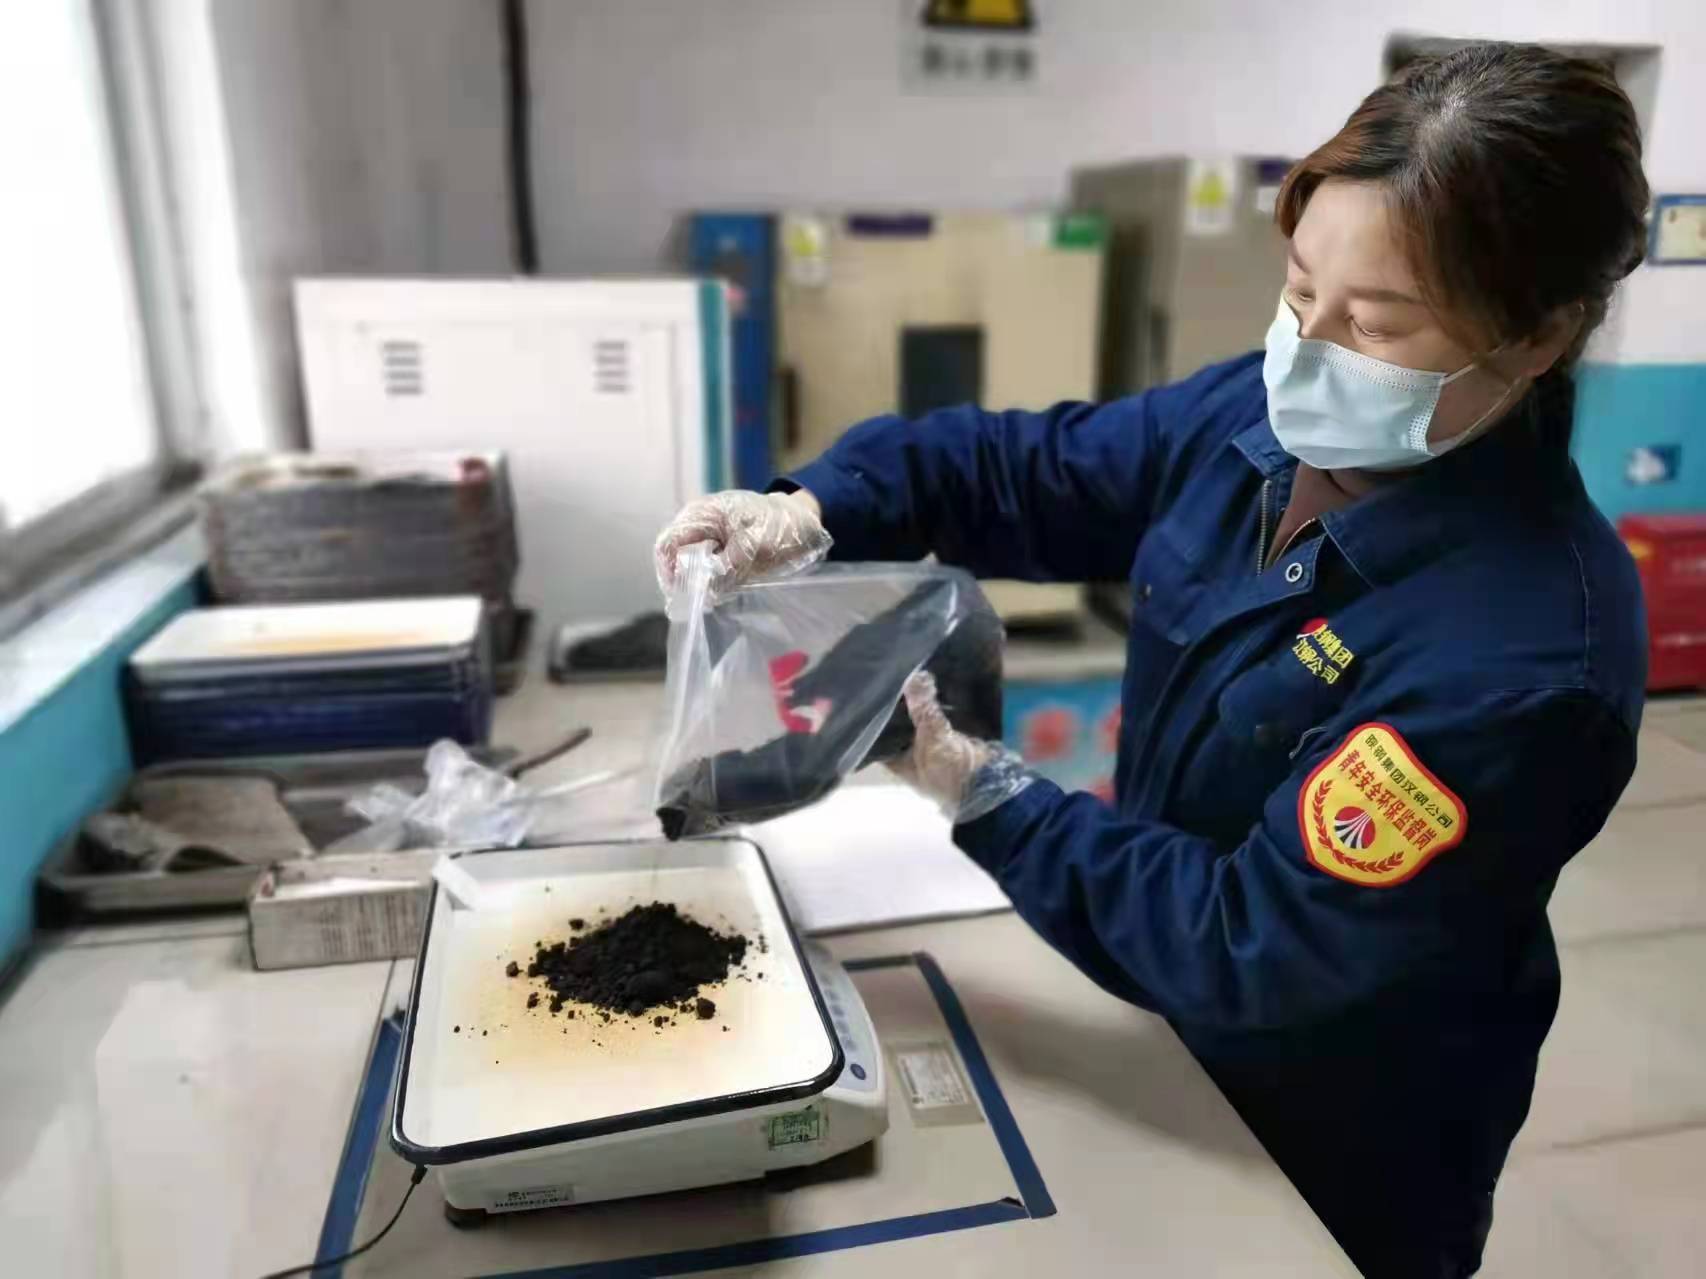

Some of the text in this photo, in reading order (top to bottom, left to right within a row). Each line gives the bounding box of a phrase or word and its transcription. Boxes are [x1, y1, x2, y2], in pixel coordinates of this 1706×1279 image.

[1338, 749, 1437, 850] 青年安全环保监督岗
